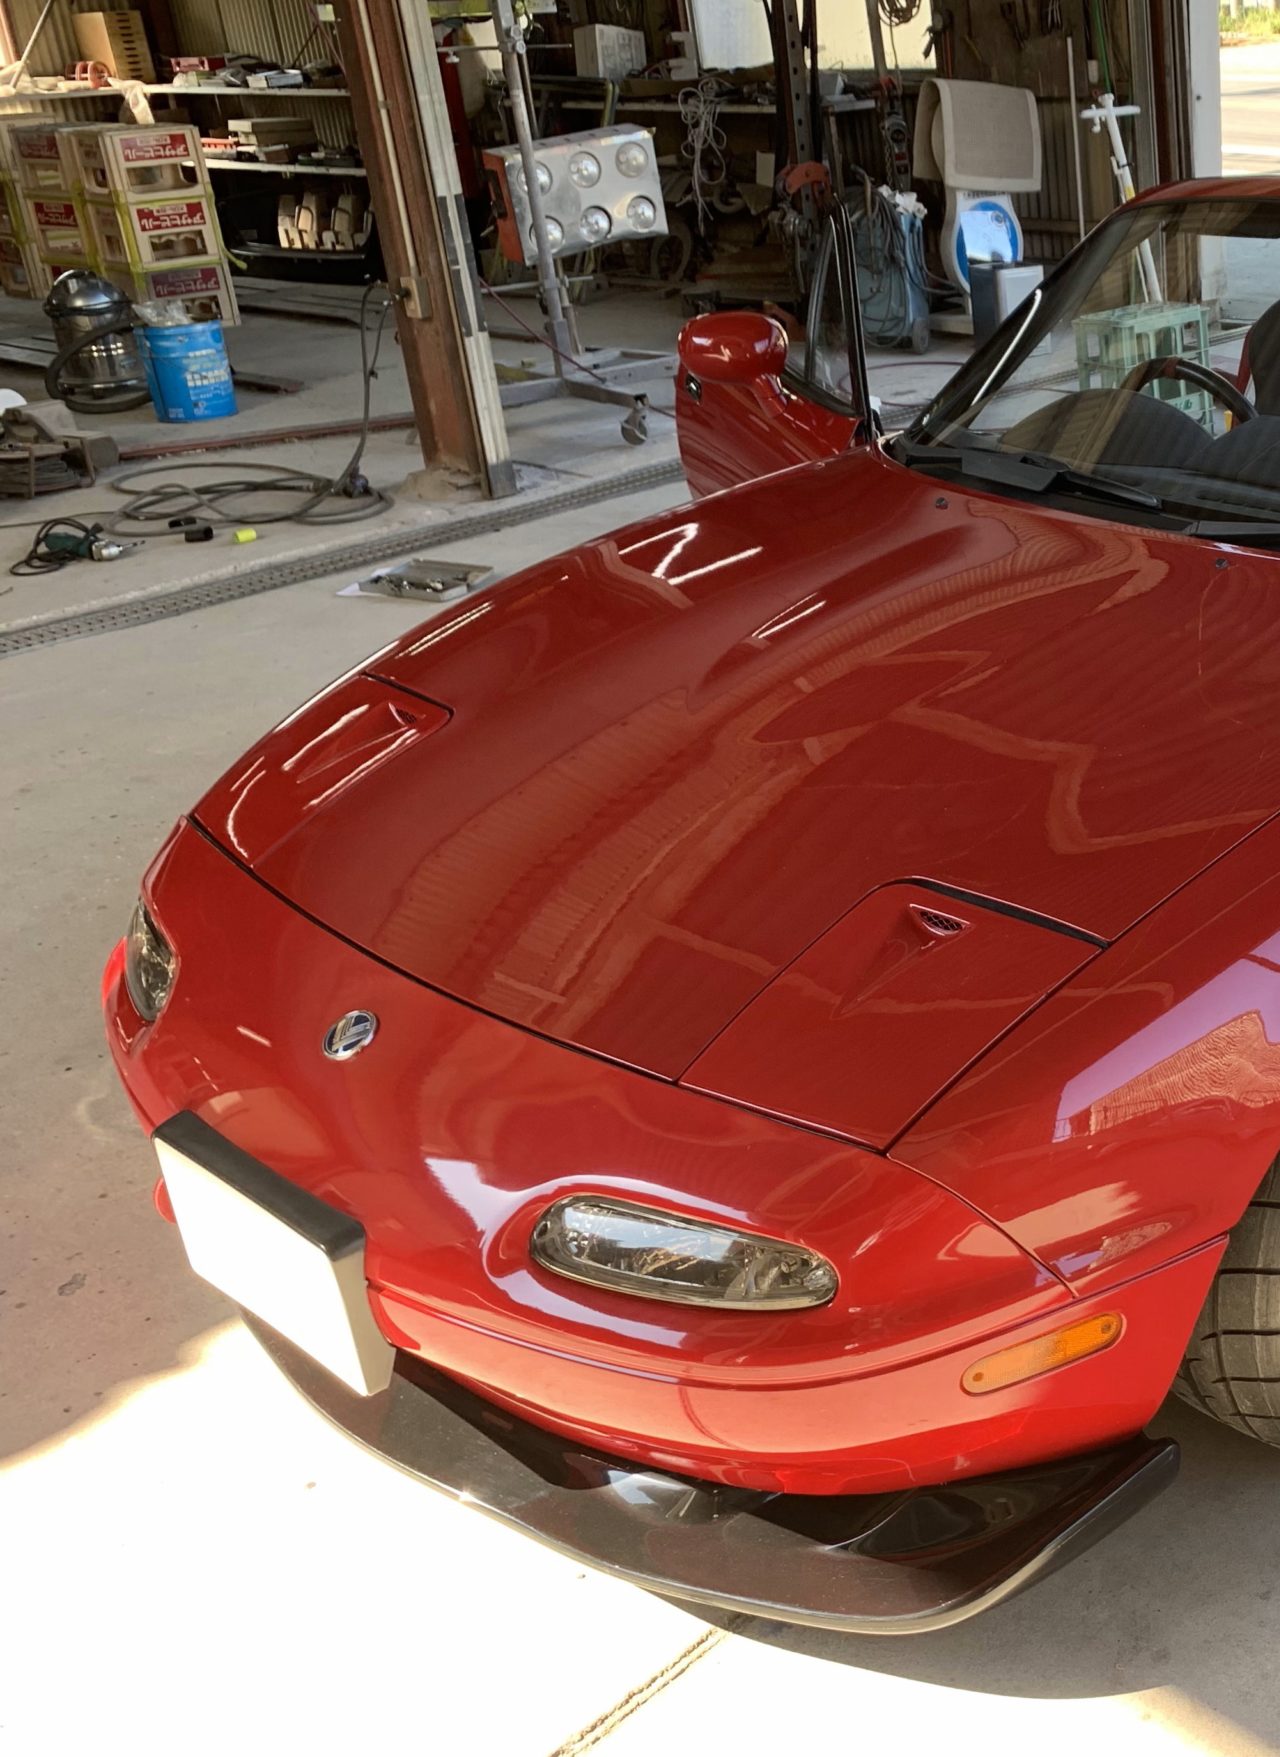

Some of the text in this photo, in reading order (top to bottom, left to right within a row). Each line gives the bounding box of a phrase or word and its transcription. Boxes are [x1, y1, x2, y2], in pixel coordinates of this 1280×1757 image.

[124, 144, 188, 160] アサヒビール
[141, 212, 204, 230] アサヒビール
[156, 277, 218, 295] アサヒビール
